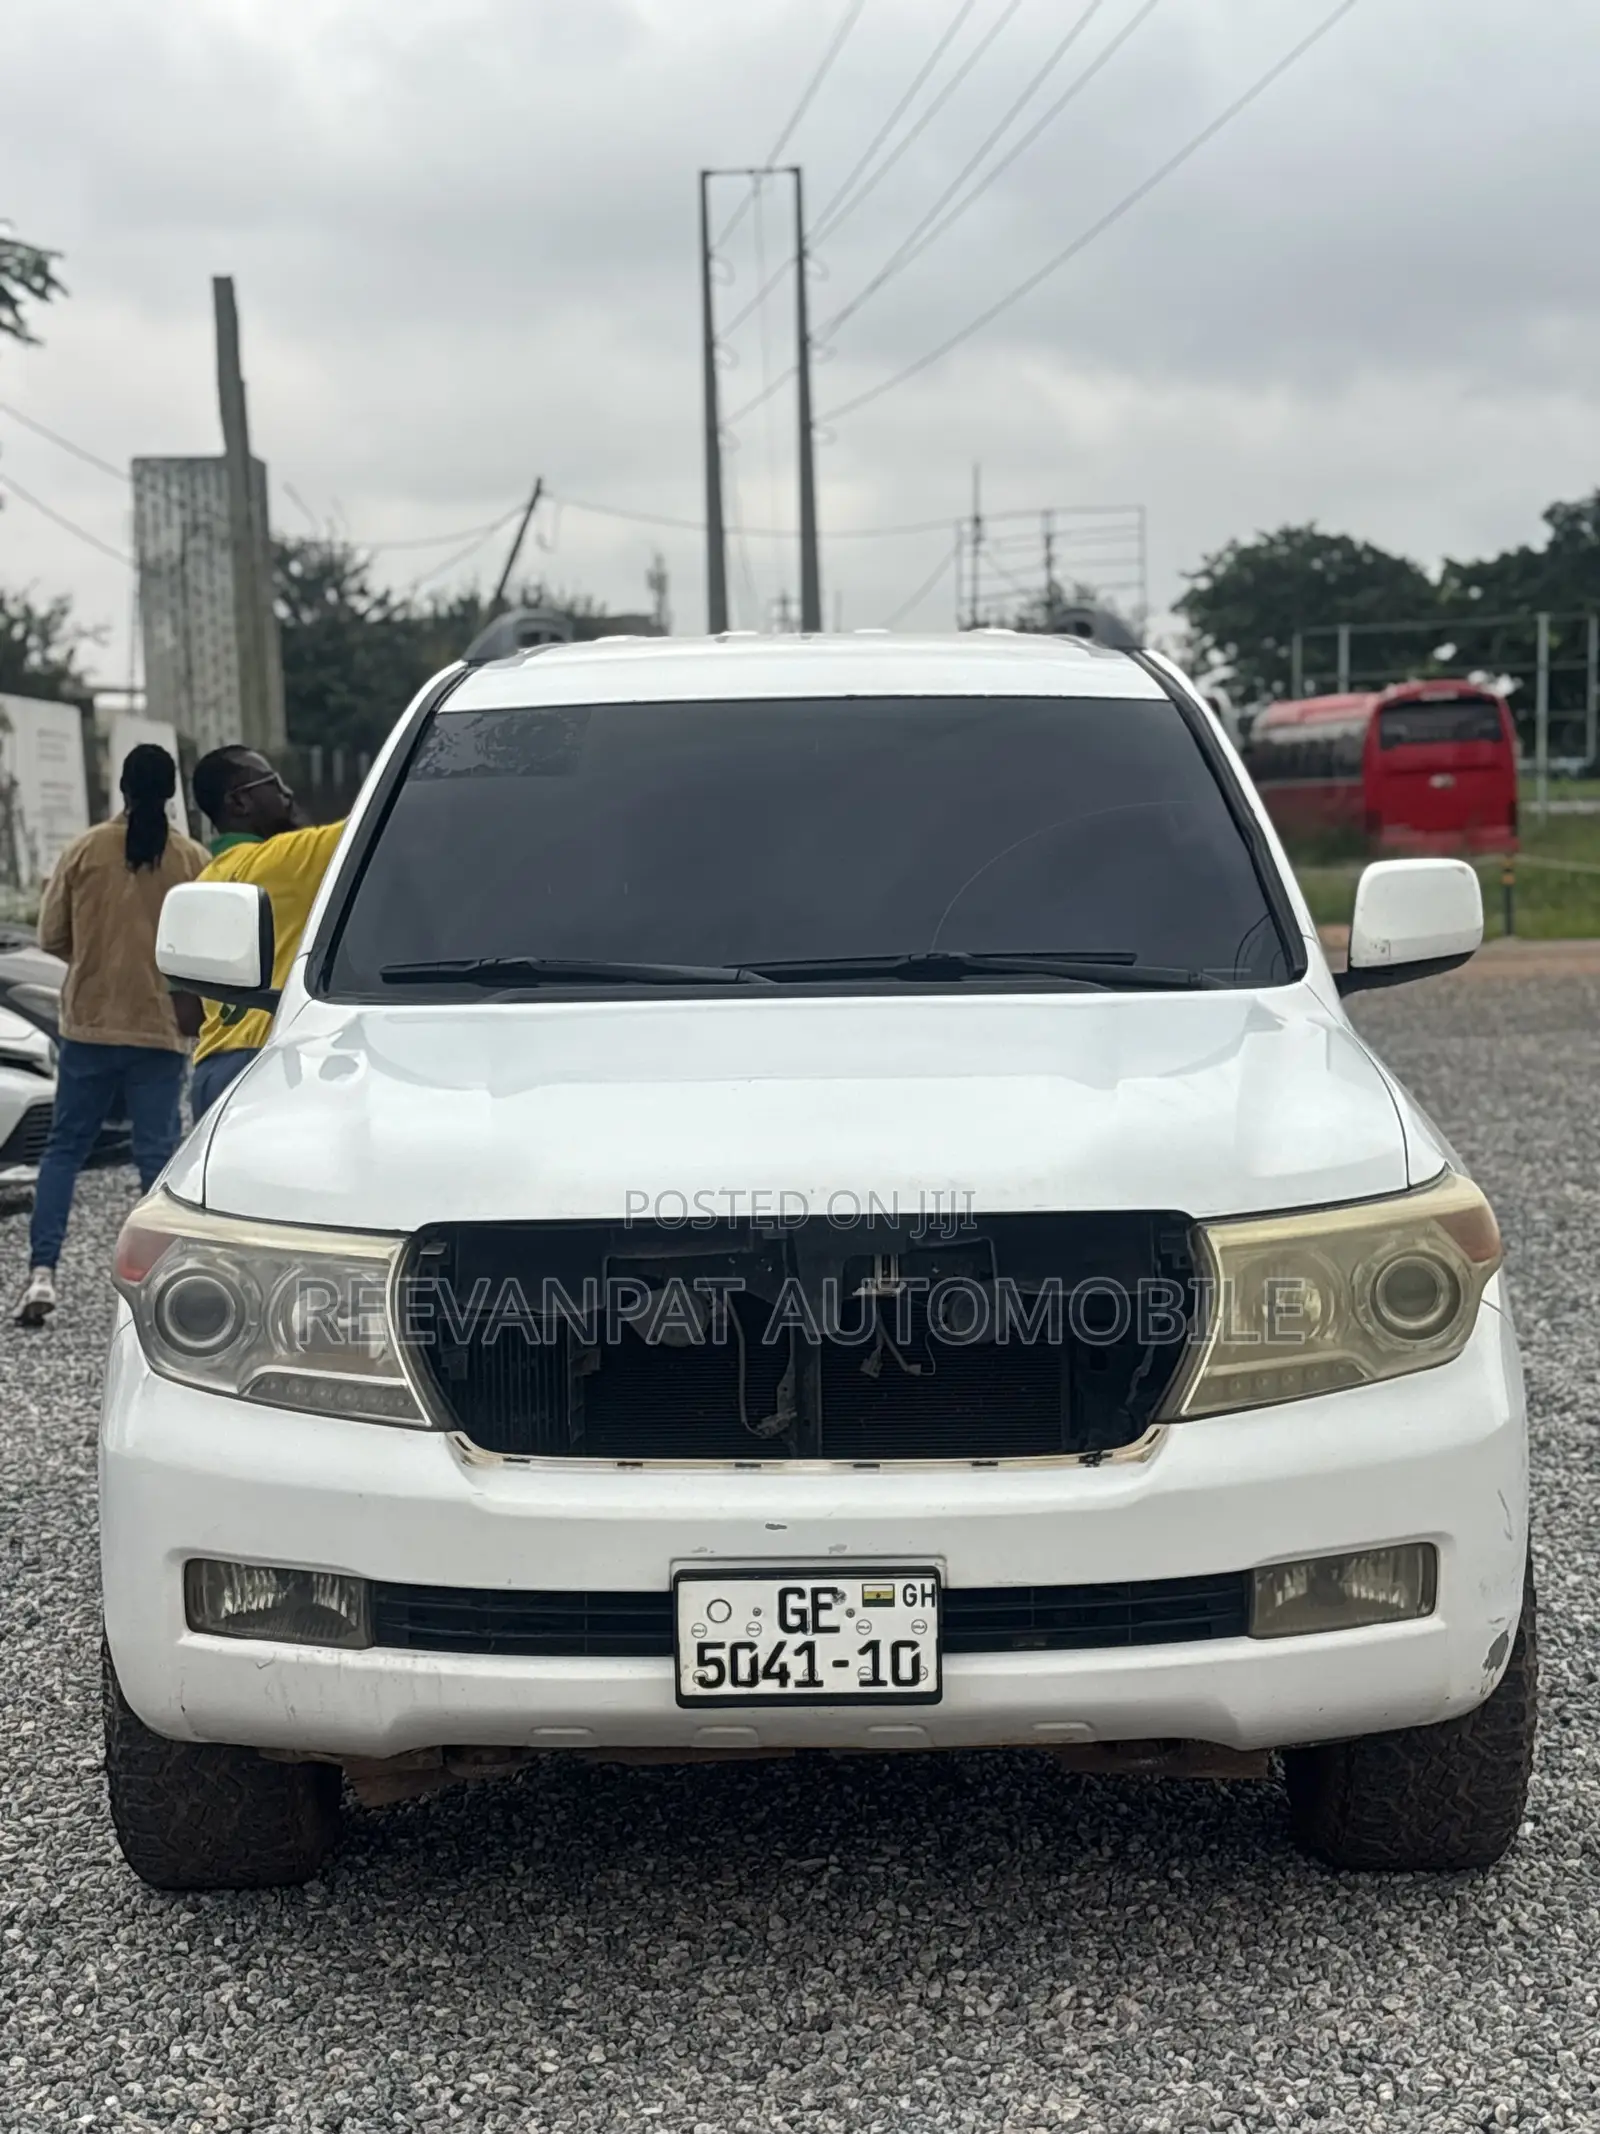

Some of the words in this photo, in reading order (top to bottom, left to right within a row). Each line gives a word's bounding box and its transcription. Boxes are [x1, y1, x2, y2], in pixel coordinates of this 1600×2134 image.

[777, 1586, 841, 1635] GE
[902, 1582, 937, 1608] GH
[696, 1639, 921, 1690] 5041-10
